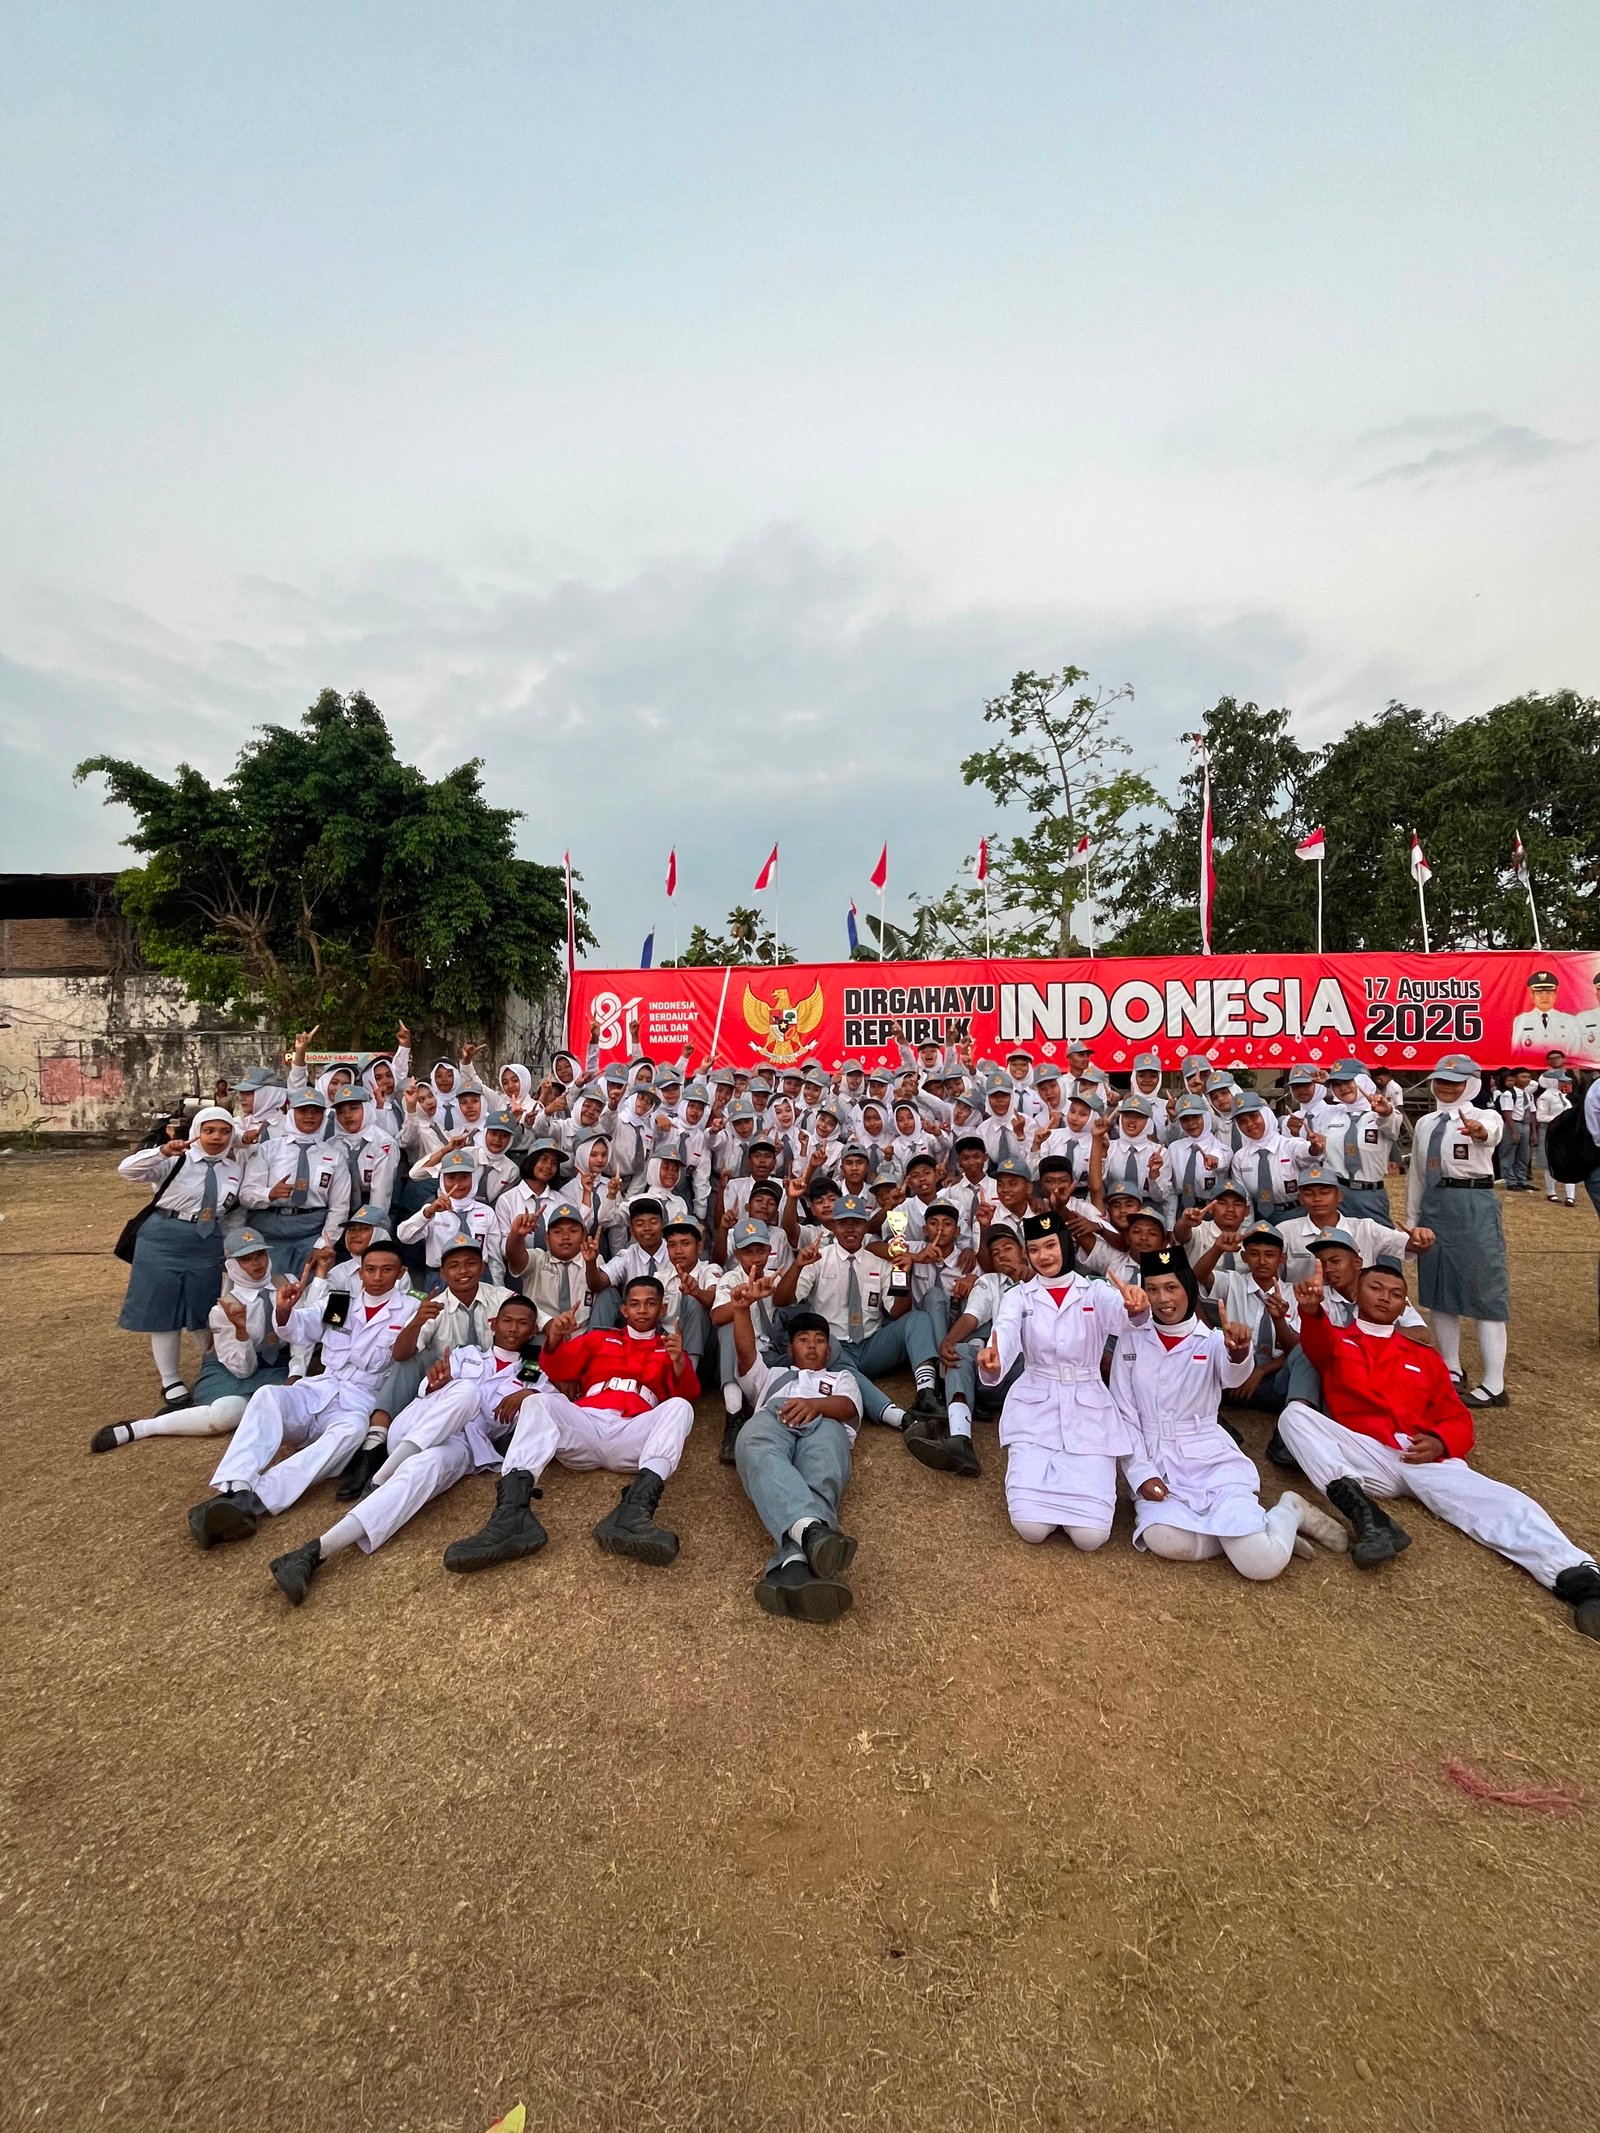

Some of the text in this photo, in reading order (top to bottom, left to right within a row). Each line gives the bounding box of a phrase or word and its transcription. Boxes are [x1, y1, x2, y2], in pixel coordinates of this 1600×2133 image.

[1364, 976, 1482, 1003] 17 Agustus
[649, 1001, 696, 1010] INDONESIA
[844, 984, 995, 1016] DIRGAHAYU
[999, 978, 1357, 1040] INDONESIA
[649, 1012, 699, 1021] BERDAULAT
[1365, 1003, 1483, 1042] 2026
[649, 1024, 689, 1032] ADIL DAN
[649, 1034, 689, 1043] MAKMUR
